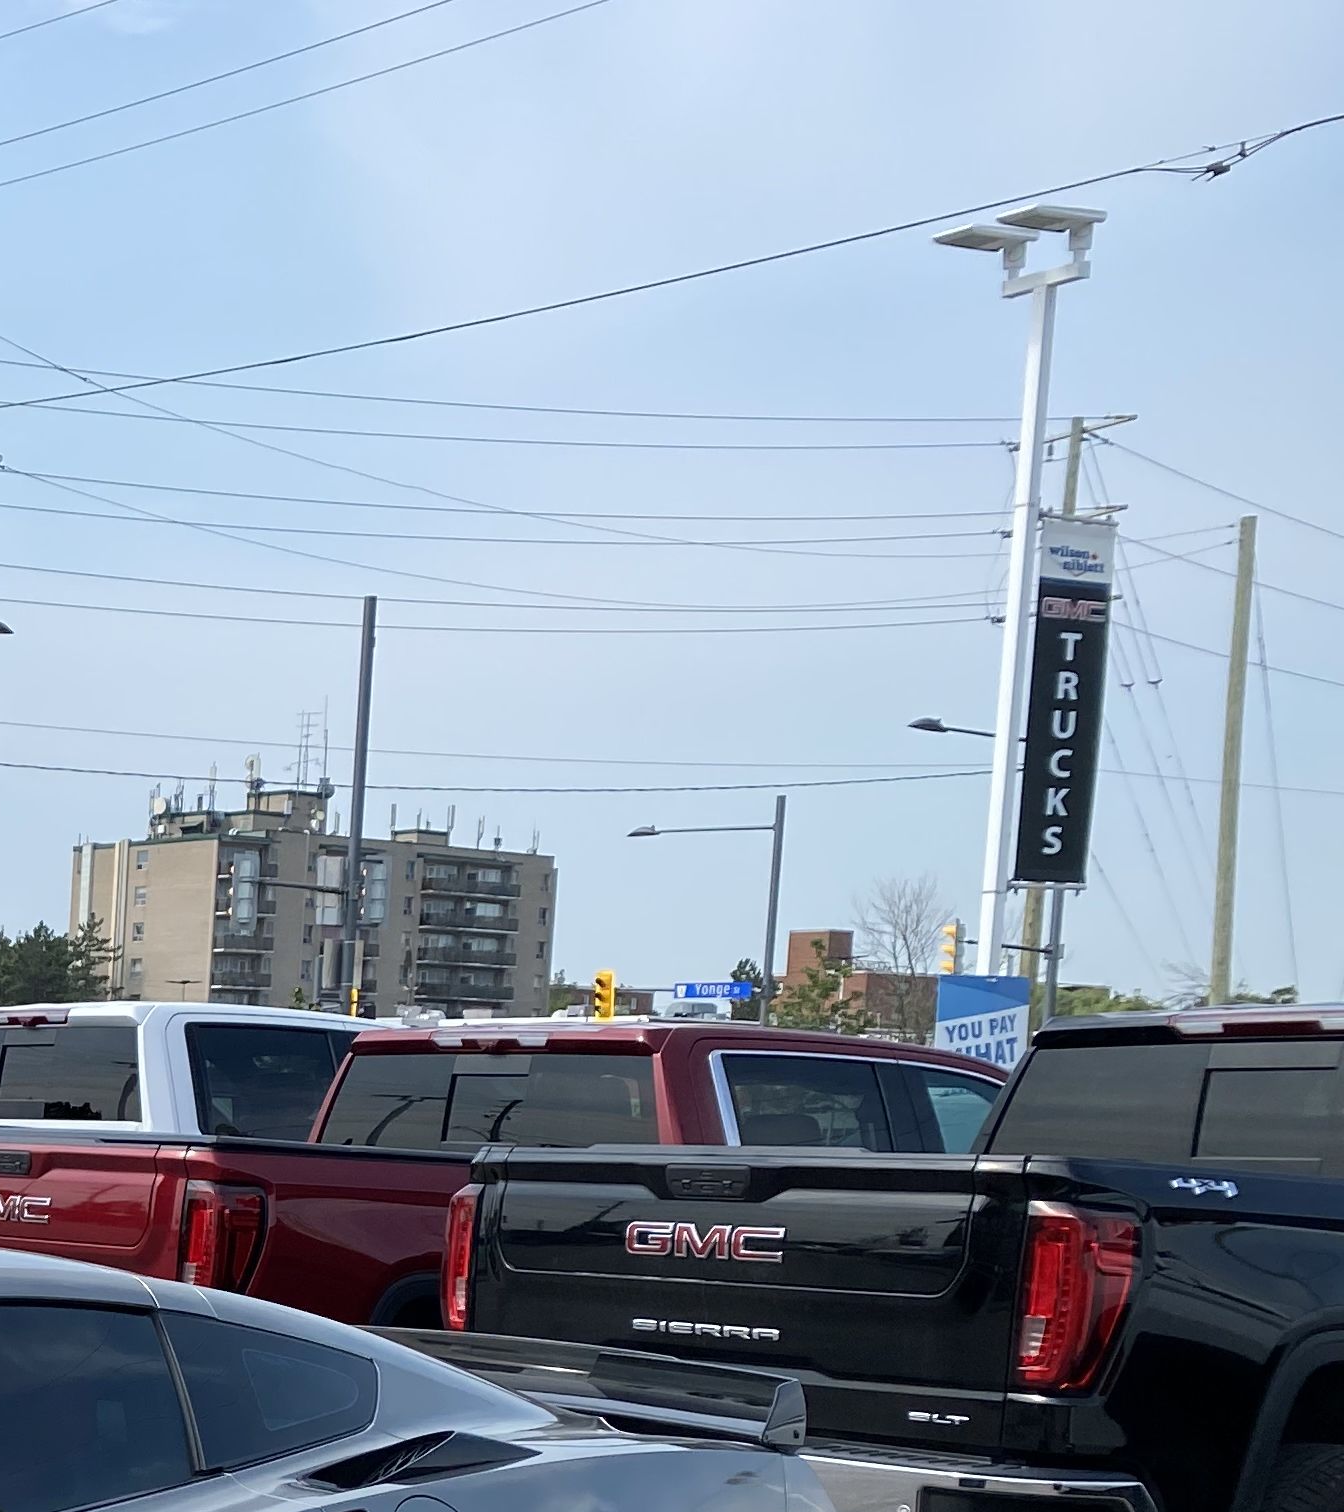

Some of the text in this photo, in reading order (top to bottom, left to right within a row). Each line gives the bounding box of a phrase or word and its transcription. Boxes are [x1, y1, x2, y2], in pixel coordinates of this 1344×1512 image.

[1042, 597, 1108, 622] GMC
[1042, 632, 1083, 855] TRUCKS
[695, 983, 730, 998] Yonge
[945, 1013, 1016, 1043] YOU PAY
[956, 1036, 1018, 1065] HAT
[624, 1221, 786, 1264] GMC
[632, 1318, 782, 1342] SIERRA
[908, 1411, 970, 1425] SLT
